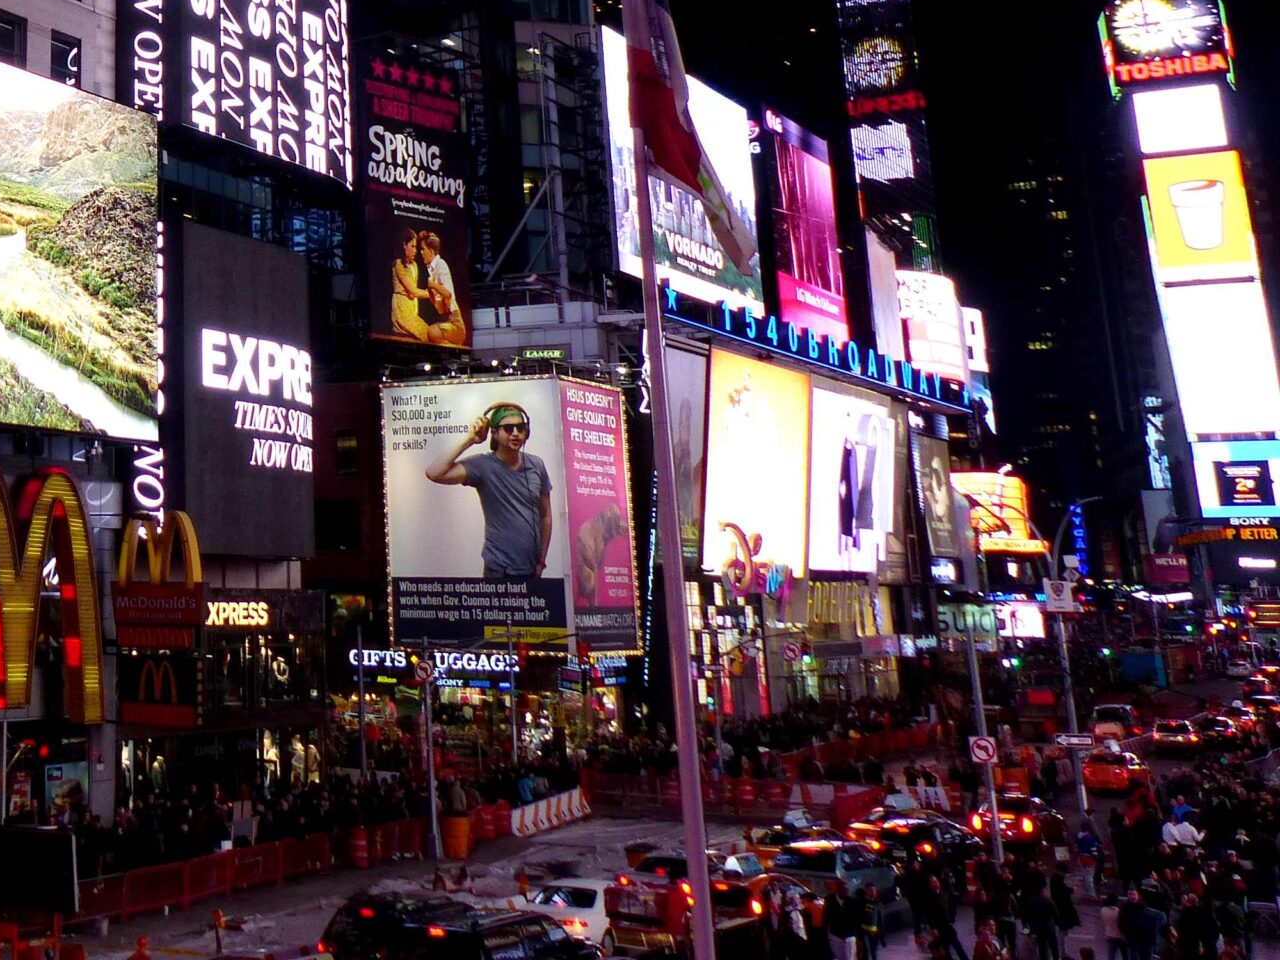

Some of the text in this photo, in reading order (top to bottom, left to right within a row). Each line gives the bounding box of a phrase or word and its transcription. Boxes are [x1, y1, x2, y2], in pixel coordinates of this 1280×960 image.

[1115, 53, 1228, 81] TOSHIBA
[368, 125, 442, 171] SPRING
[367, 156, 466, 209] awakening
[665, 229, 724, 270] VORNADO
[392, 394, 438, 408] What? get
[234, 400, 287, 434] TIMES
[392, 409, 452, 423] $30,000 year
[567, 407, 616, 429] GIVE SQUAT TO
[392, 424, 469, 437] with no experience
[570, 427, 615, 448] PET SHELTERS
[393, 439, 428, 451] or skills?
[250, 438, 291, 469] NOW
[1230, 517, 1270, 526] SONY
[1240, 528, 1278, 540] BETTER
[400, 581, 527, 593] Who needs education hard
[116, 596, 196, 610] McDonald's
[400, 595, 545, 609] work when Gov. Cuomo raising the
[400, 608, 550, 622] minimum wage 15 dollars hour?
